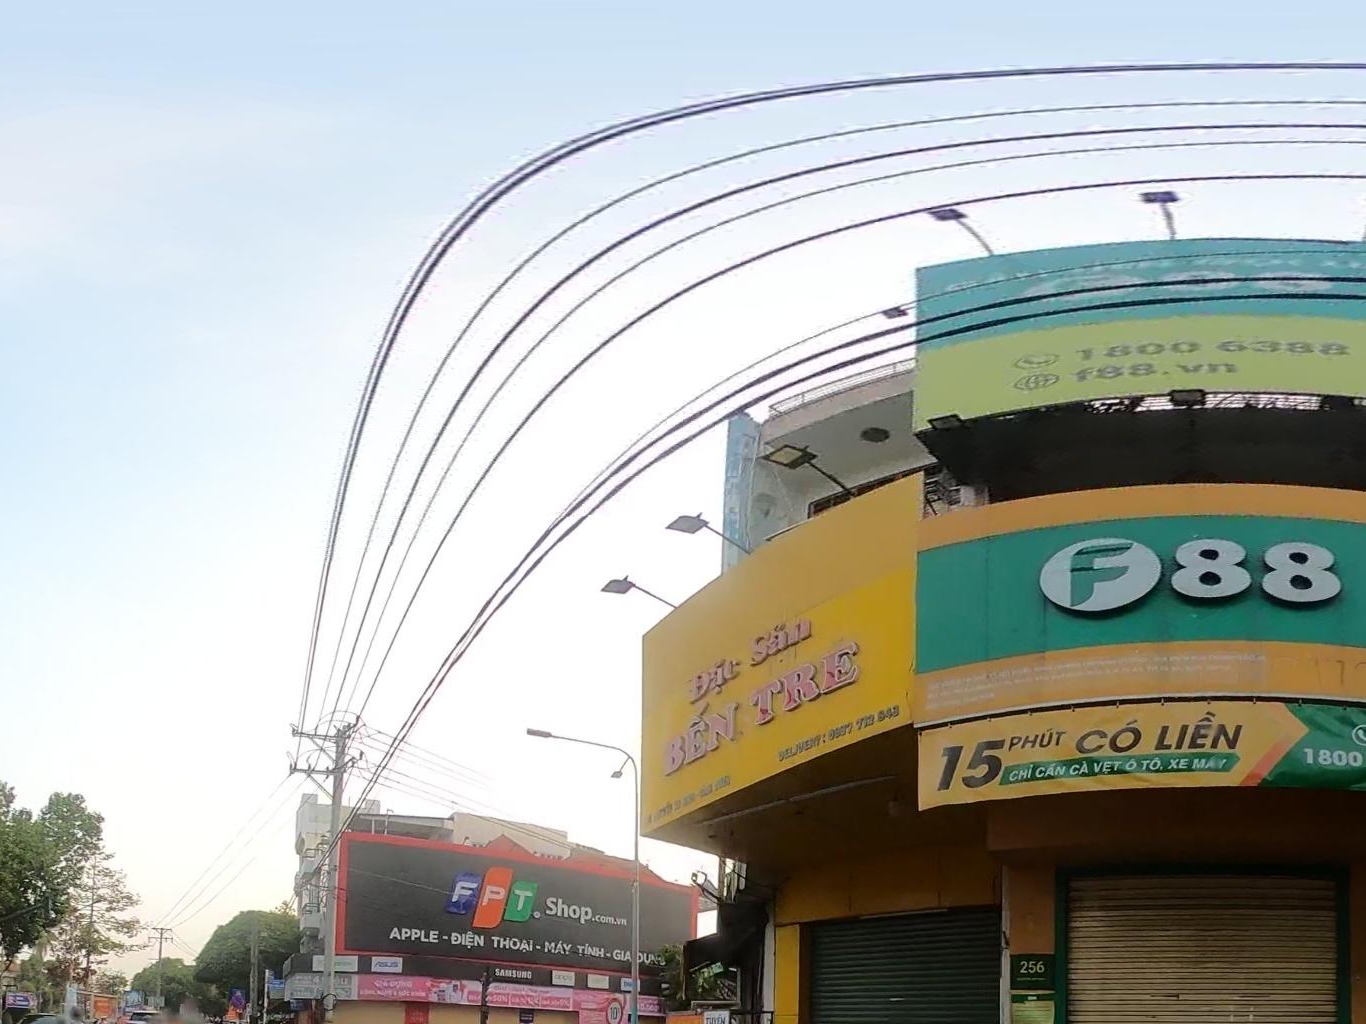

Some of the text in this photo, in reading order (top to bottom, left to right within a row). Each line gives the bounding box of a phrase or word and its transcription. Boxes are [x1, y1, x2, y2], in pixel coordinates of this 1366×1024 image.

[1075, 340, 1200, 361] 1800
[1039, 537, 1342, 612] F88
[663, 701, 739, 776] BẾN
[749, 641, 860, 725] TRE
[937, 710, 1244, 792] 15 PHÚT CÓ LIỀN
[1303, 747, 1364, 768] 1800
[1008, 763, 1033, 783] CHỈ
[1070, 758, 1090, 776] CÀ
[1093, 759, 1123, 776] VẸT
[1168, 758, 1189, 770] XE
[450, 880, 535, 912] FPT
[389, 927, 439, 944] APPLE
[450, 931, 485, 949] ĐIỆN
[491, 935, 533, 952] THOẠI
[544, 939, 572, 955] MÁY
[577, 943, 604, 959] TÍNH
[612, 949, 632, 962] GIA
[494, 968, 532, 979] SAMSUNG
[1019, 960, 1045, 974] 256
